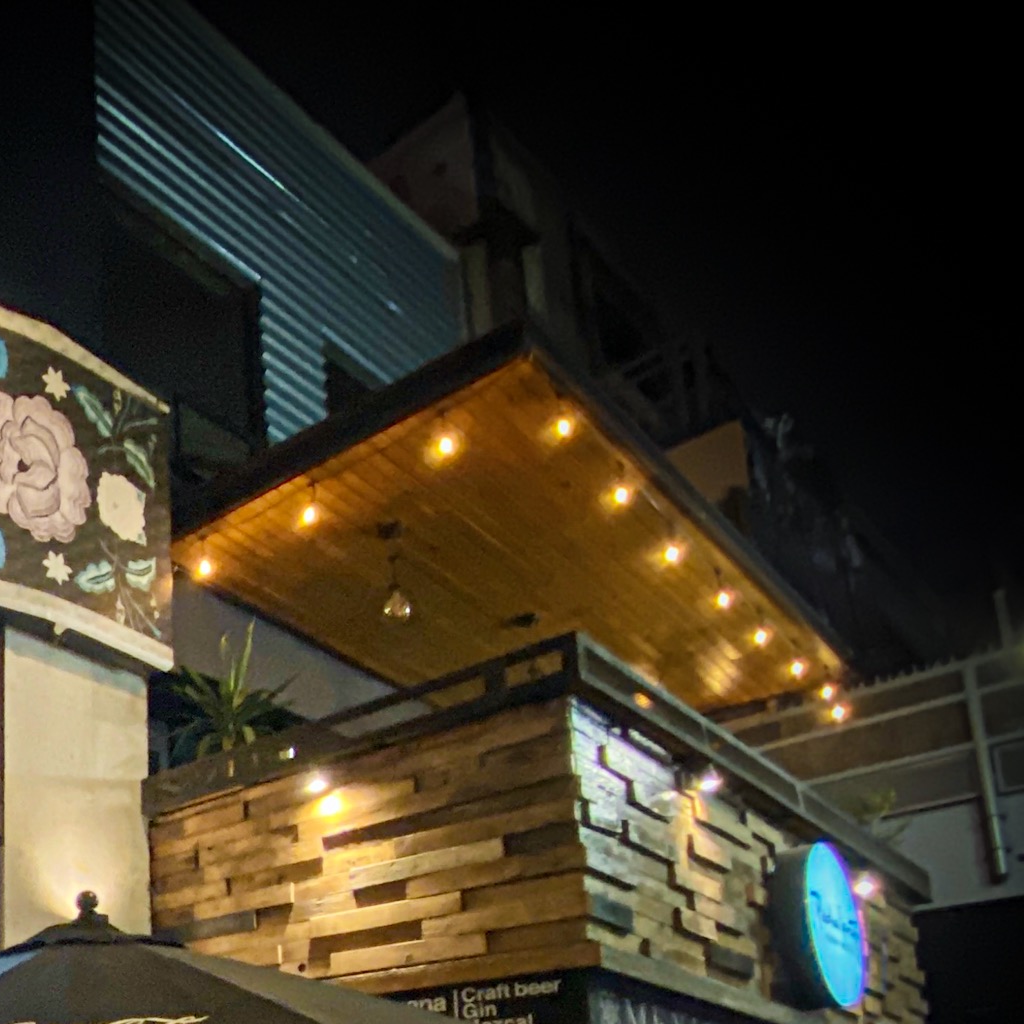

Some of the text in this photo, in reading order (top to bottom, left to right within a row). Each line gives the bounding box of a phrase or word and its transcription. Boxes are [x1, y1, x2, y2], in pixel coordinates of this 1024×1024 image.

[461, 978, 563, 1002] Craft beer
[461, 1002, 498, 1019] Gin
